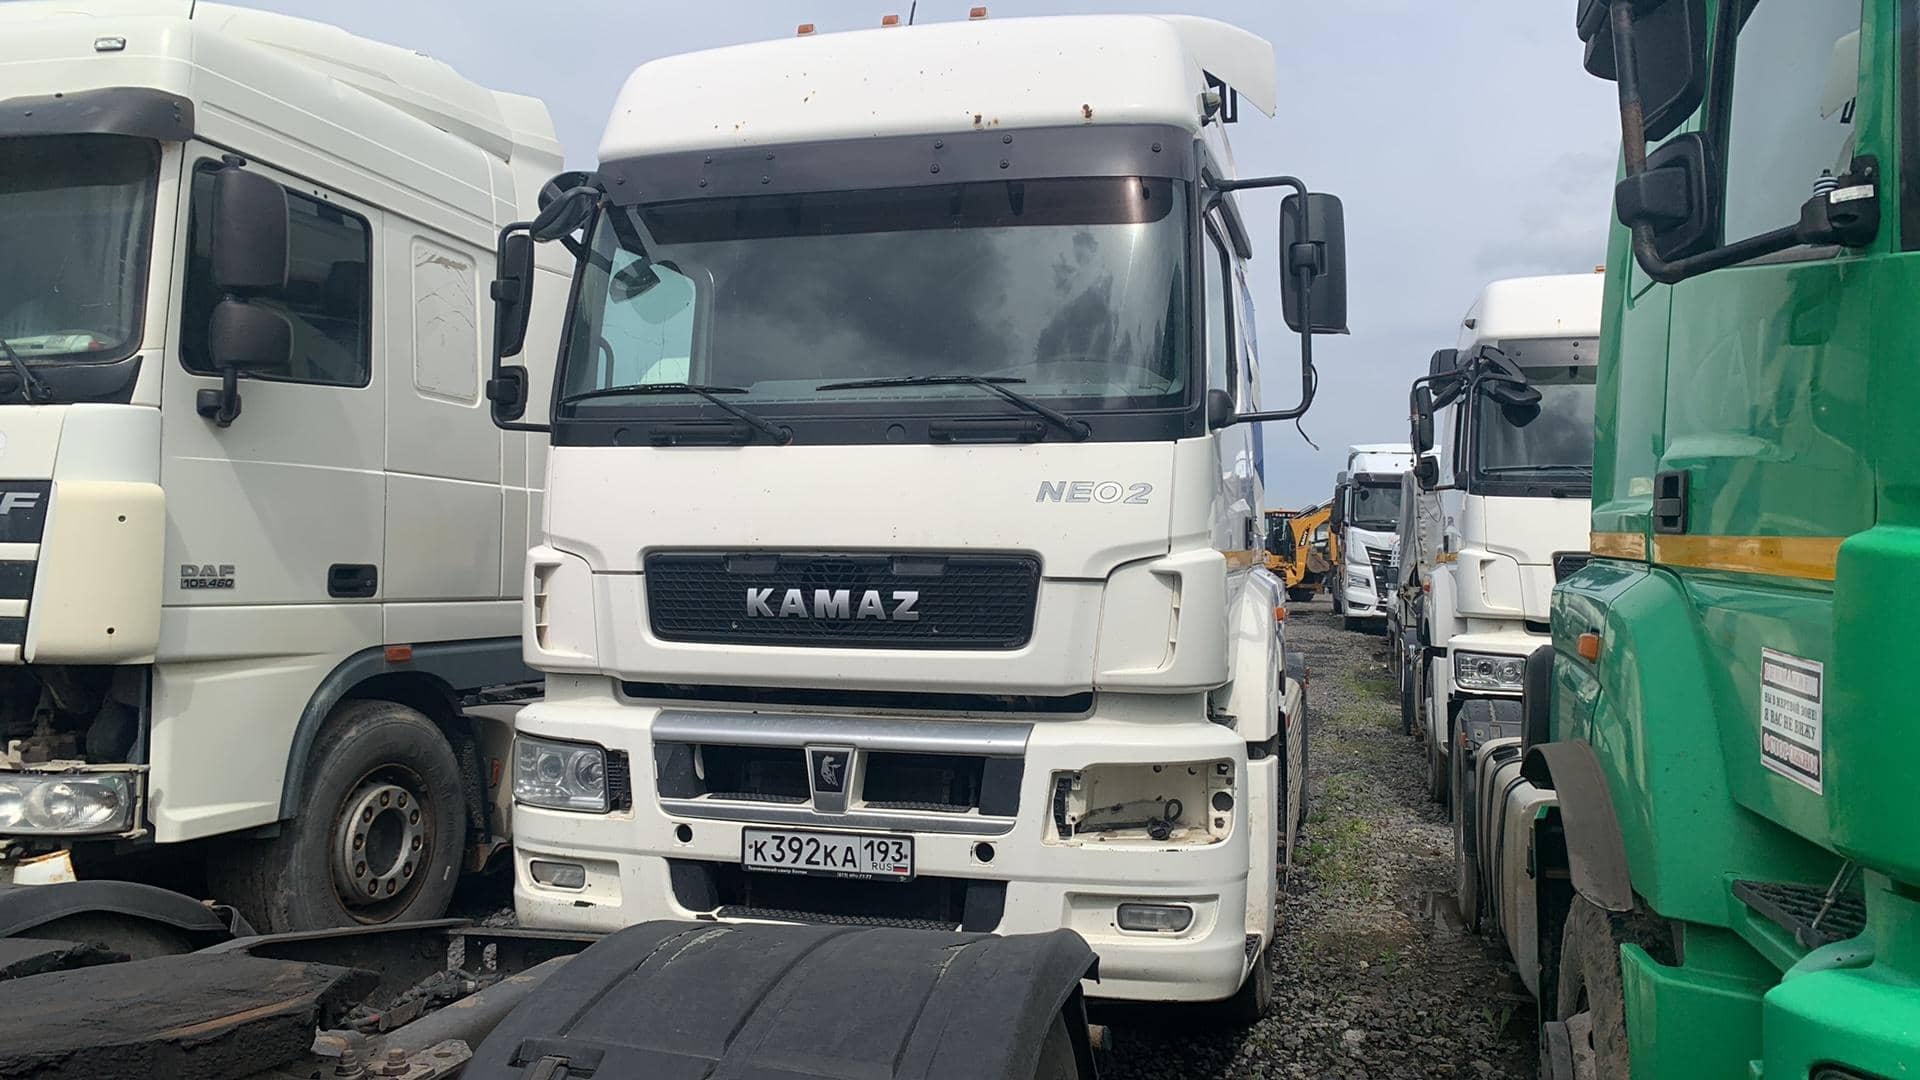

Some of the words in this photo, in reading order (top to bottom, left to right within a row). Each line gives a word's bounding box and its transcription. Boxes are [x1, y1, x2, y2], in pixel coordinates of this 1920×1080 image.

[1036, 481, 1153, 504] NEO2
[181, 564, 235, 577] DAF
[746, 588, 920, 621] KAMAZ
[863, 840, 904, 863] 193
[871, 862, 893, 872] RUS
